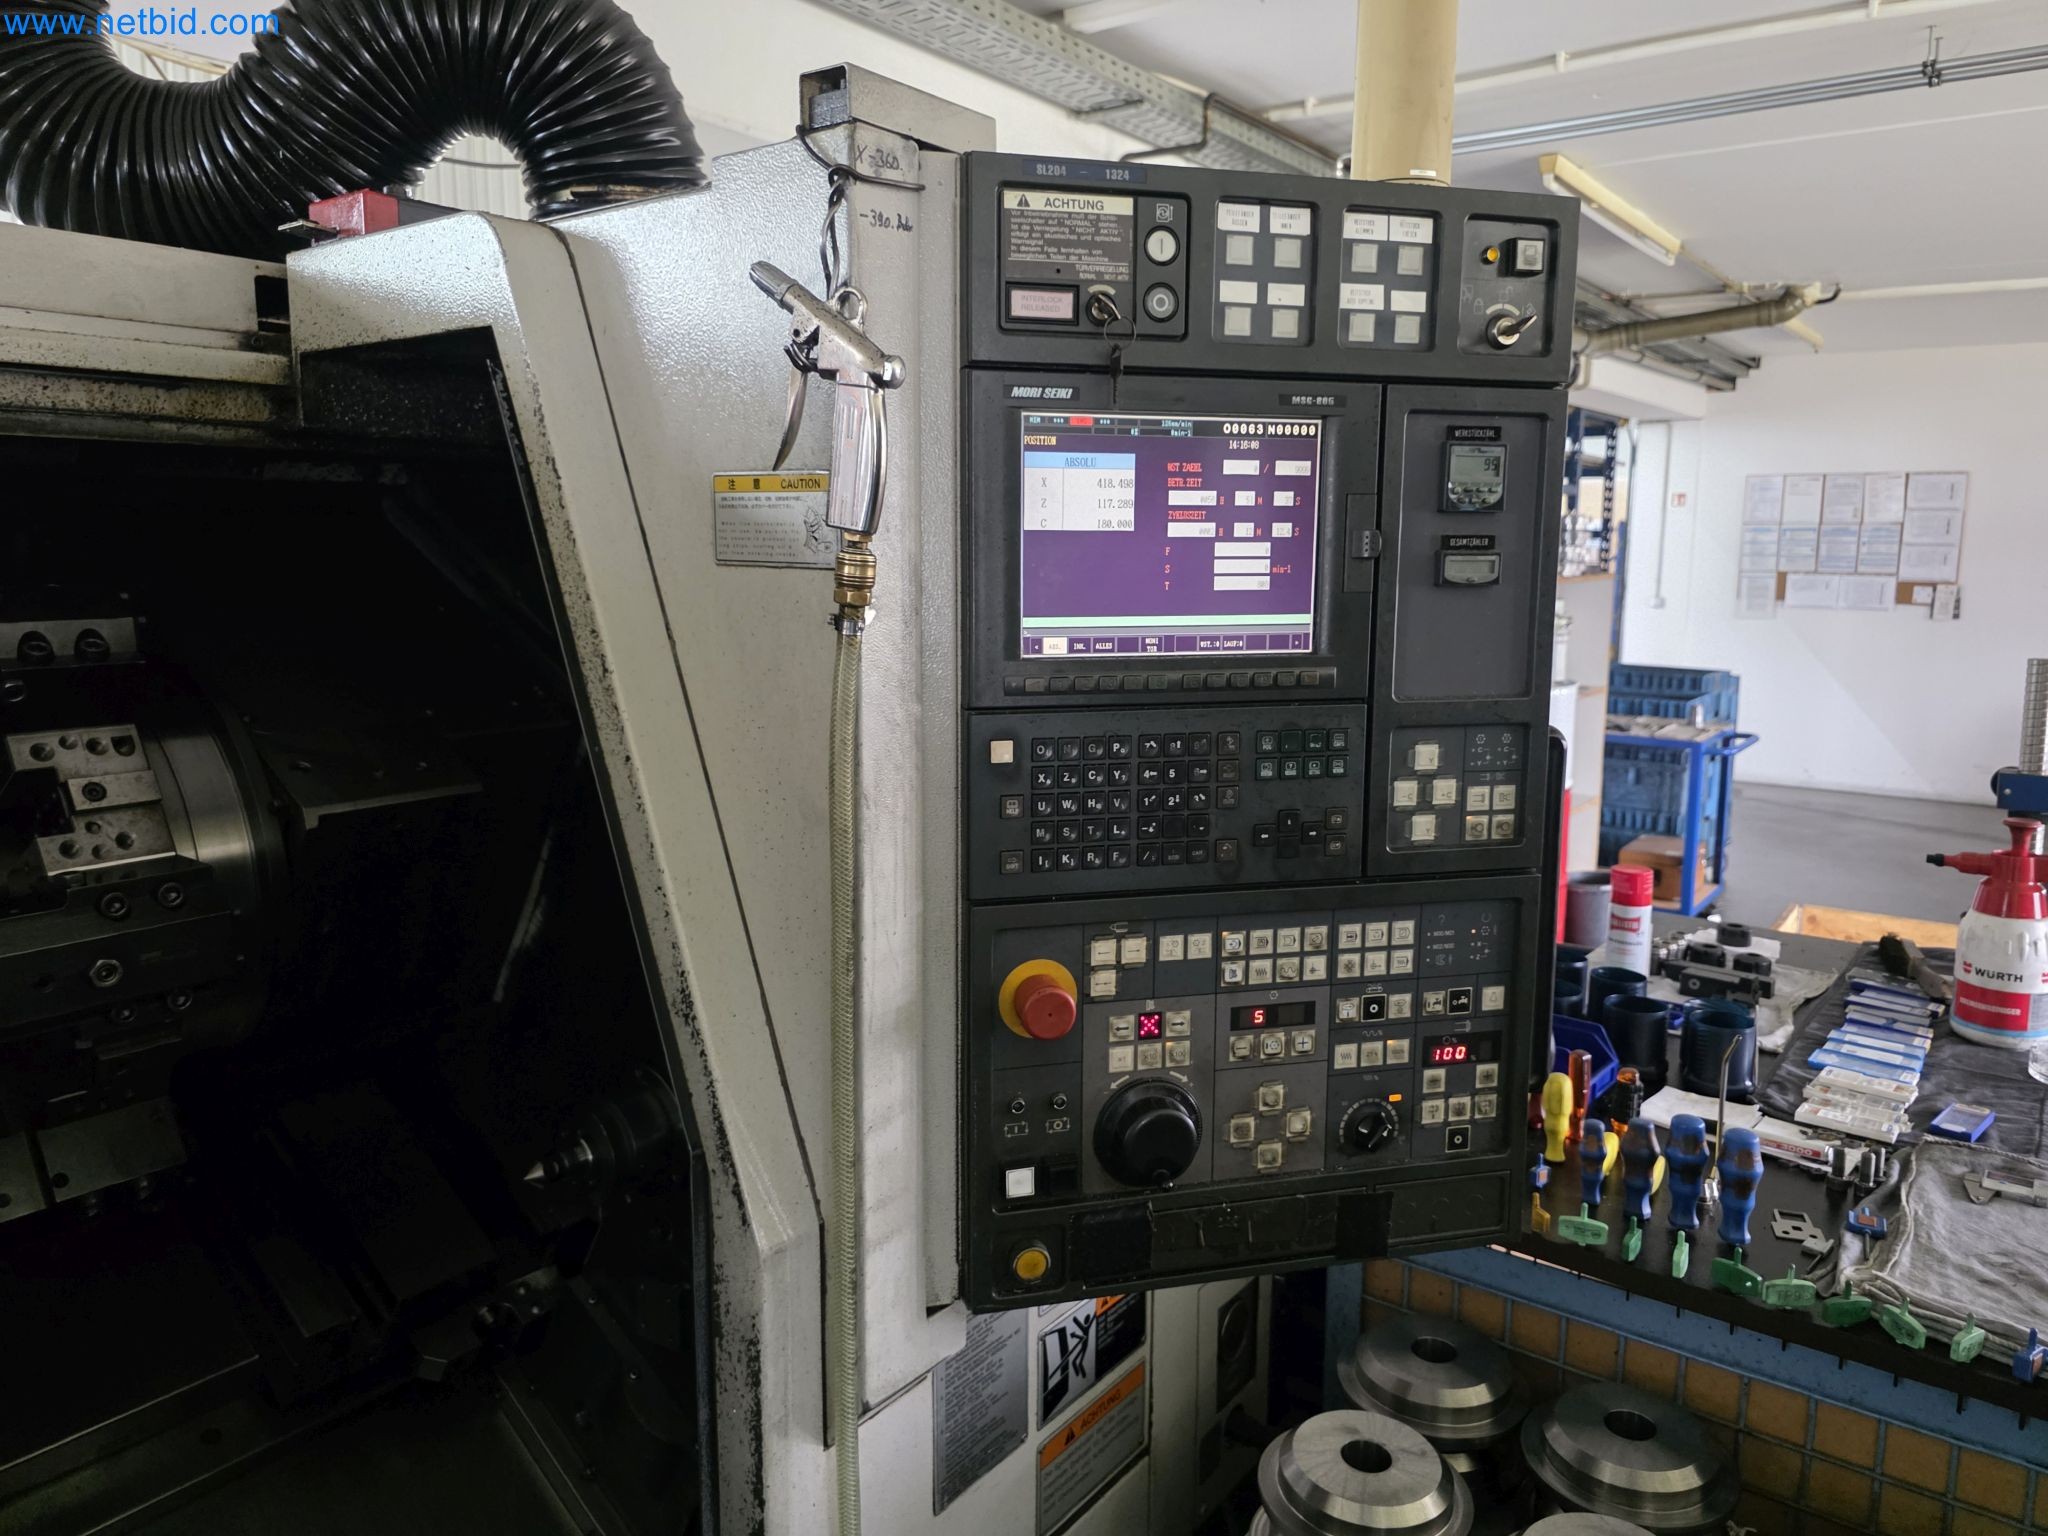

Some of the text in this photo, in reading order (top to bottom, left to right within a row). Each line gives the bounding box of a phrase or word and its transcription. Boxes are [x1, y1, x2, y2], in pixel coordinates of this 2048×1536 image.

[1036, 164, 1067, 177] SL204
[1105, 169, 1130, 181] 1324
[1044, 197, 1105, 211] ACHTUNG
[1011, 386, 1073, 399] MORI SEIKI
[1024, 435, 1057, 446] POSITION
[1064, 457, 1097, 468] ABSOLU
[780, 478, 821, 490] CAUTION
[1041, 477, 1134, 489] X 418.498
[1040, 497, 1134, 509] Z 117.289
[1040, 518, 1133, 529] C 180.000
[1095, 642, 1113, 650] ALLES
[1169, 769, 1175, 778] 5
[1974, 966, 2023, 983] WÜRTH
[1434, 1045, 1466, 1061] 100
[1781, 1143, 1813, 1156] 3000
